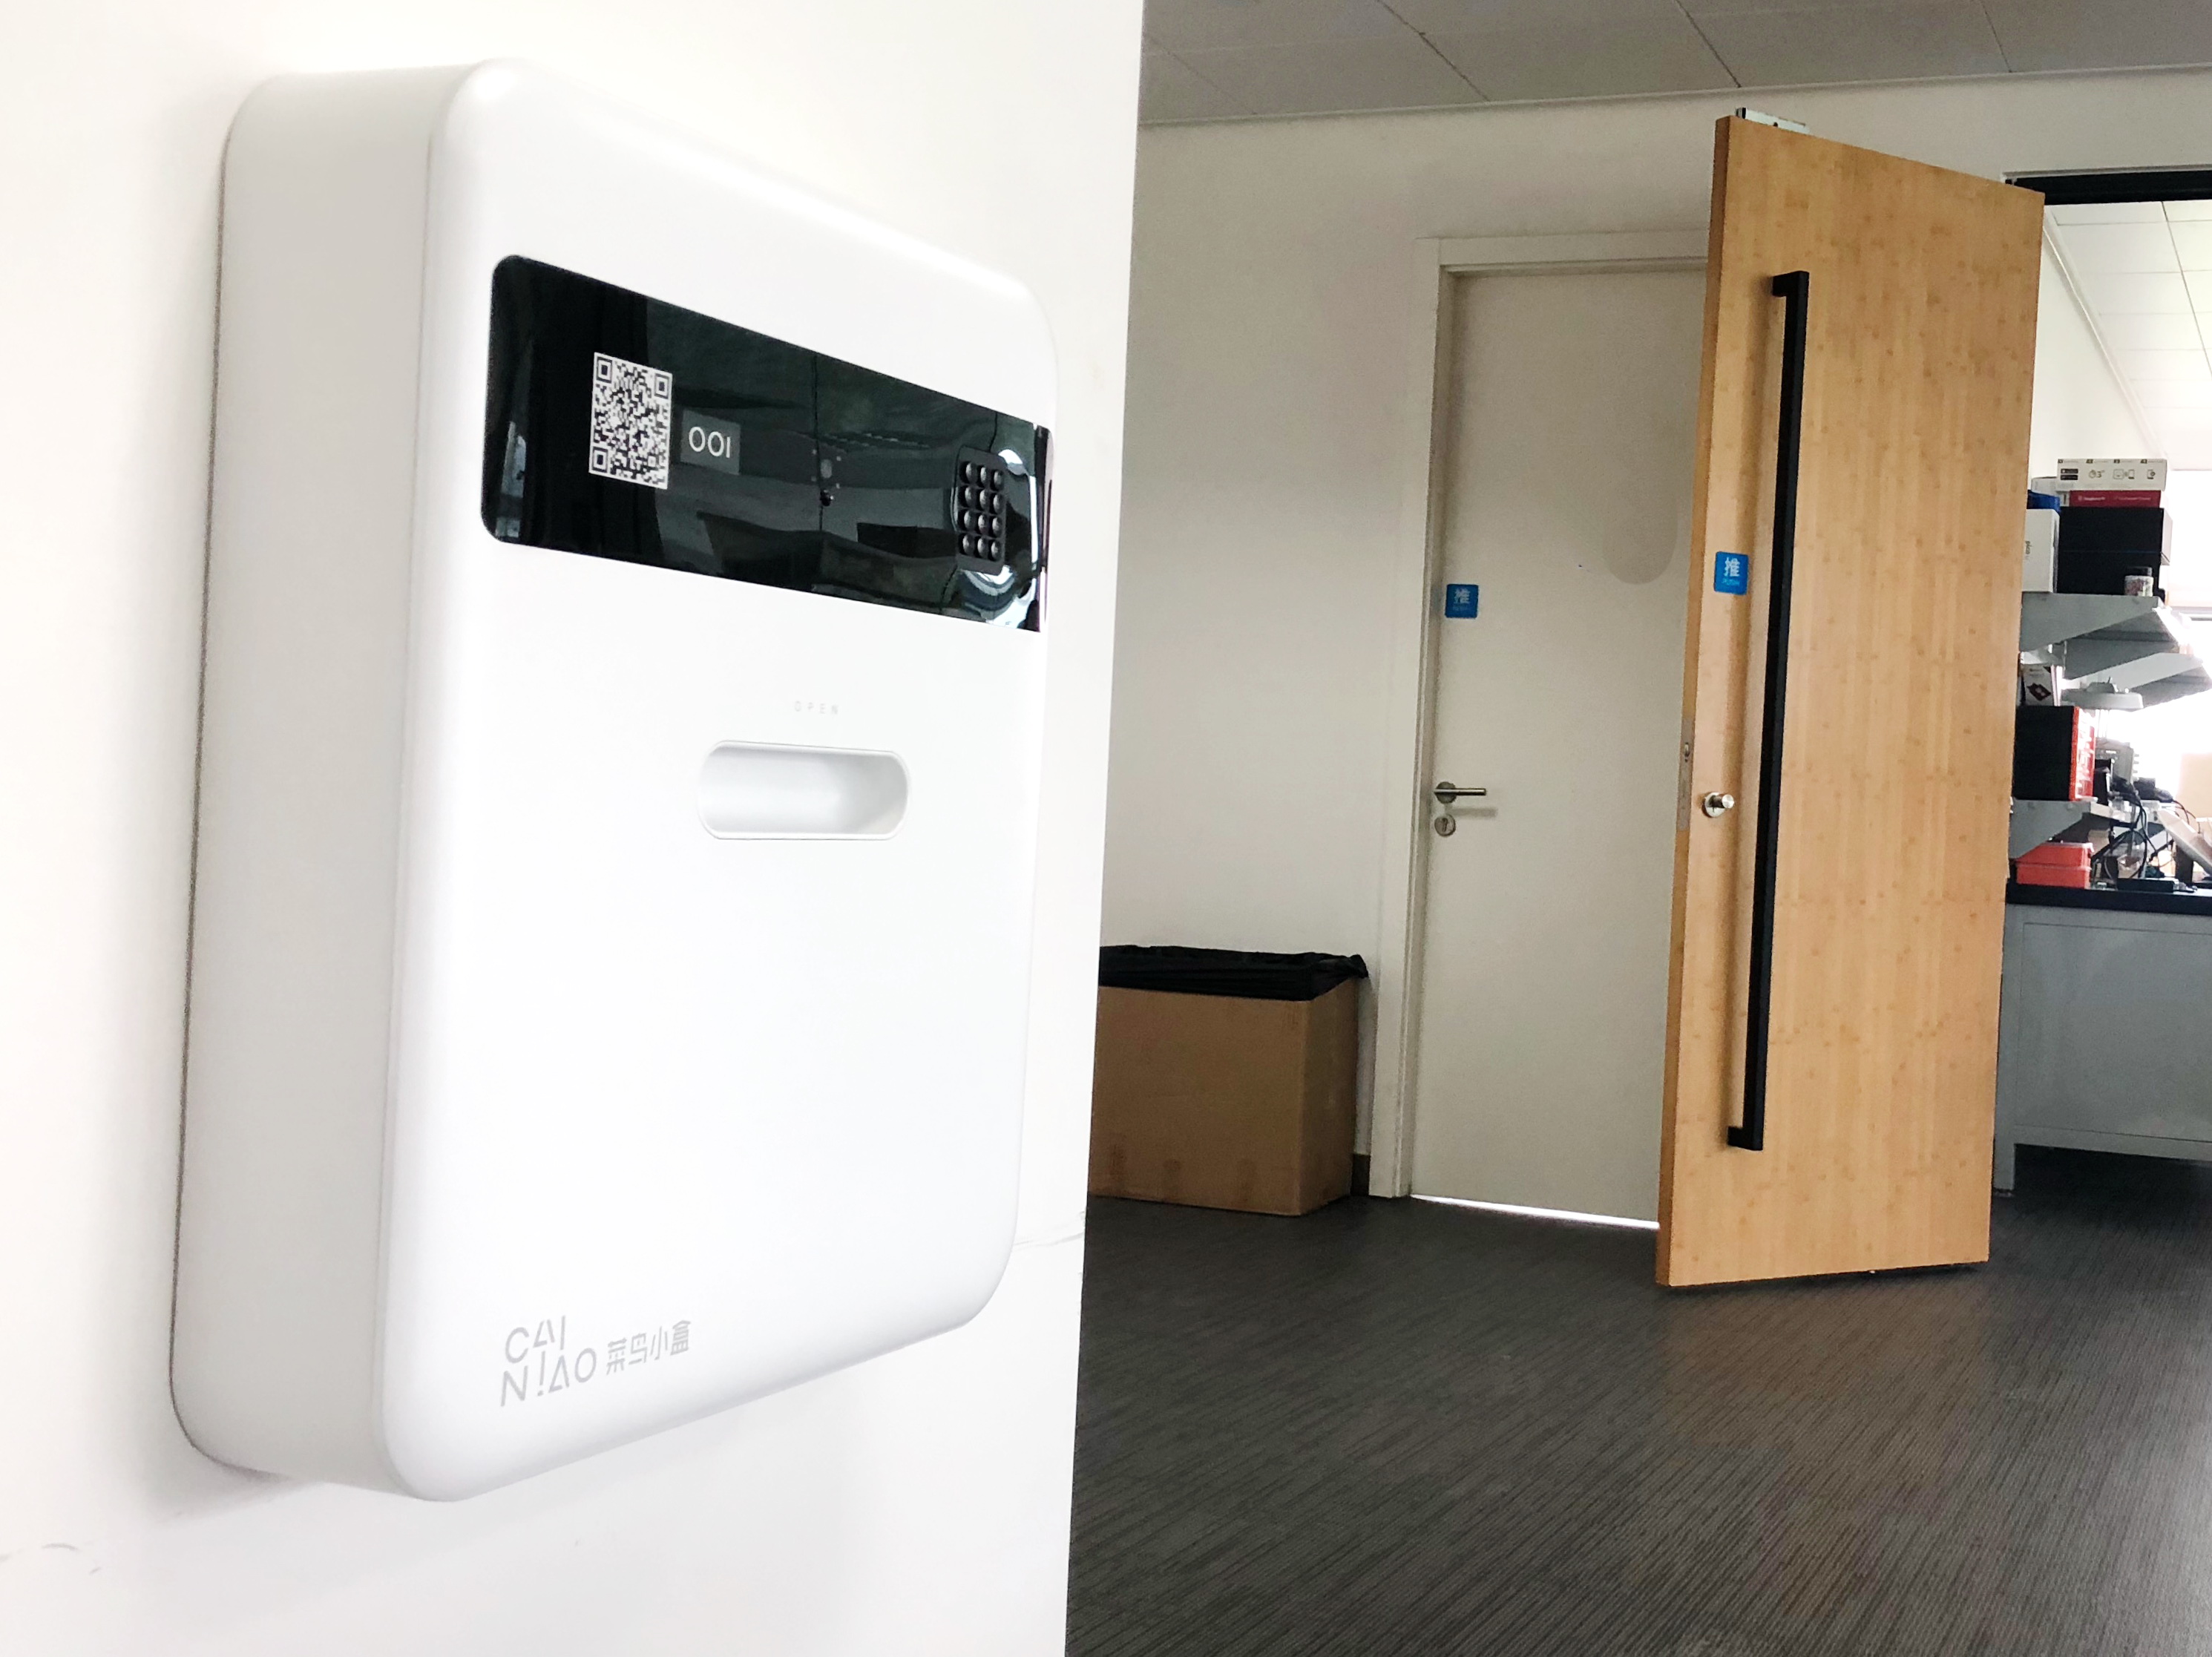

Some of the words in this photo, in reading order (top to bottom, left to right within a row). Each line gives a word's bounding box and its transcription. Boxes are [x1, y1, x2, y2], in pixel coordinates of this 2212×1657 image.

[689, 426, 731, 458] 001
[1723, 557, 1741, 577] 推
[1454, 588, 1471, 604] 推
[794, 700, 839, 715] OPEN
[505, 1315, 566, 1363] CAI
[605, 1319, 692, 1376] 菜鸟小盒
